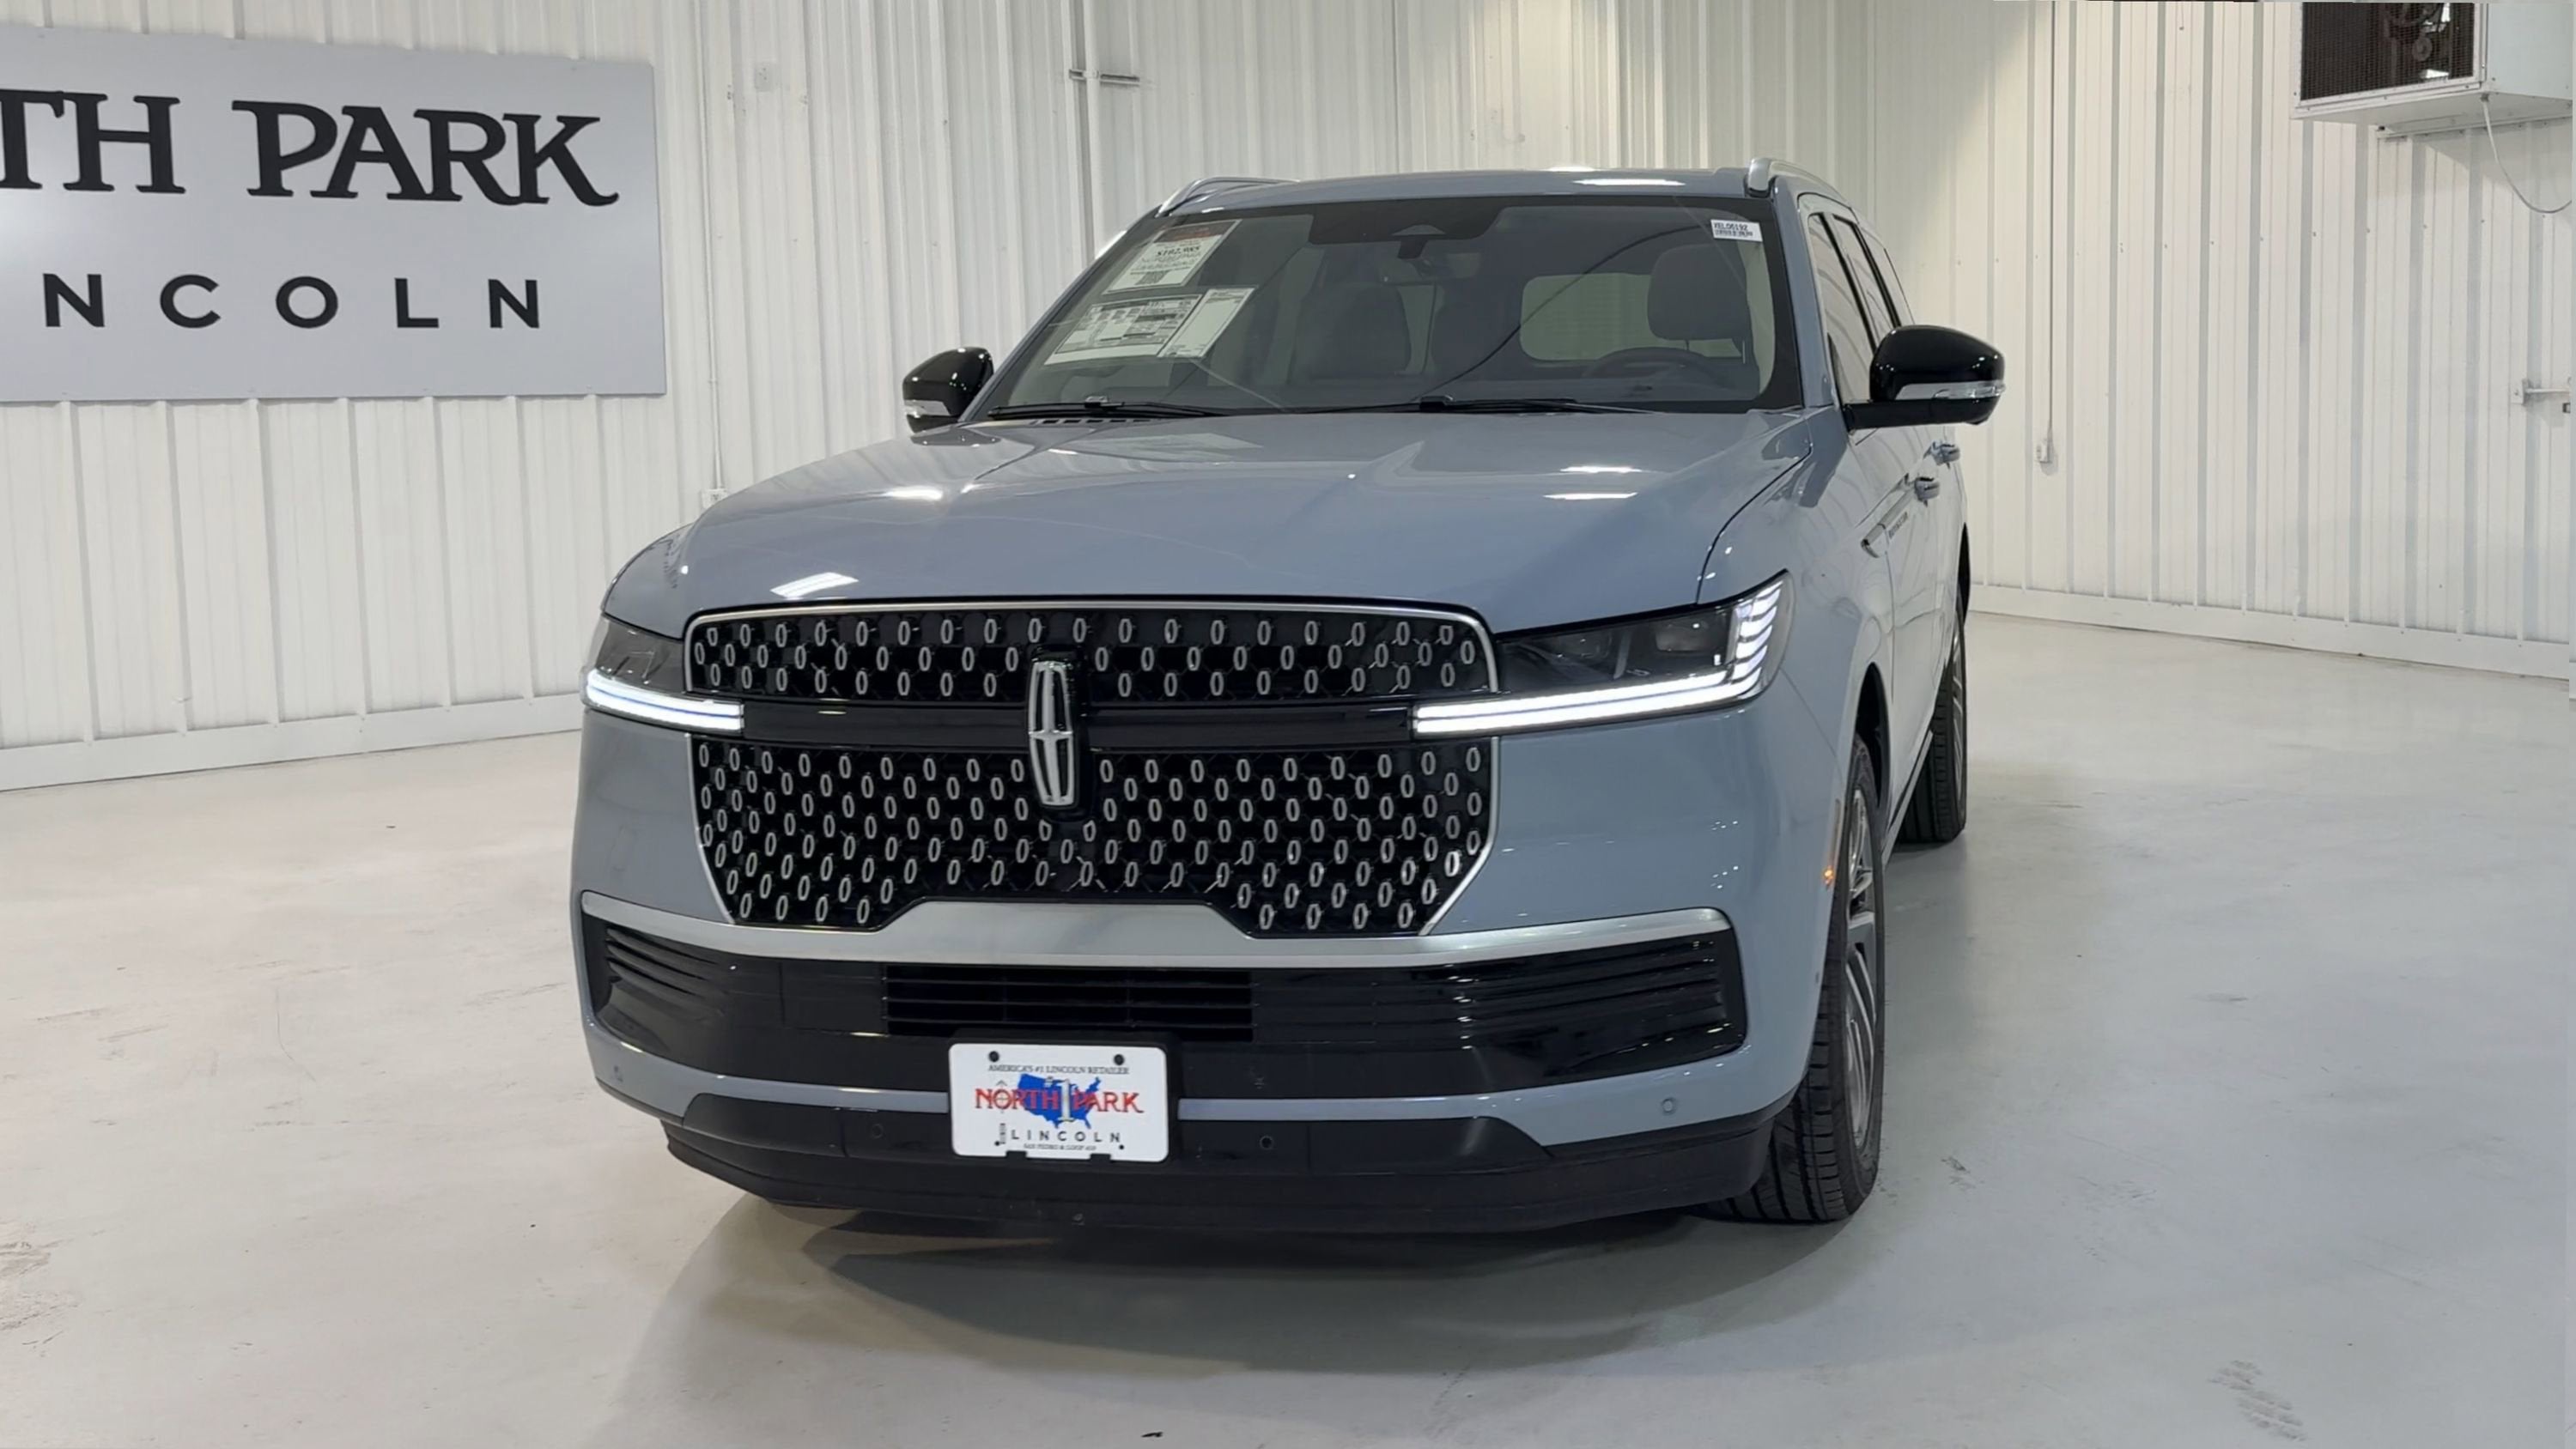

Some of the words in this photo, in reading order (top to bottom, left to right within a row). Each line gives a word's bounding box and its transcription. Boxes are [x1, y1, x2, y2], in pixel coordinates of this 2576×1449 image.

[232, 100, 619, 207] PARK
[43, 273, 539, 329] NCOLN
[1088, 1066, 1129, 1075] RETAILER
[975, 1088, 1060, 1110] NORTH
[1073, 1090, 1145, 1113] PARK
[1011, 1130, 1121, 1143] LINCOLN
